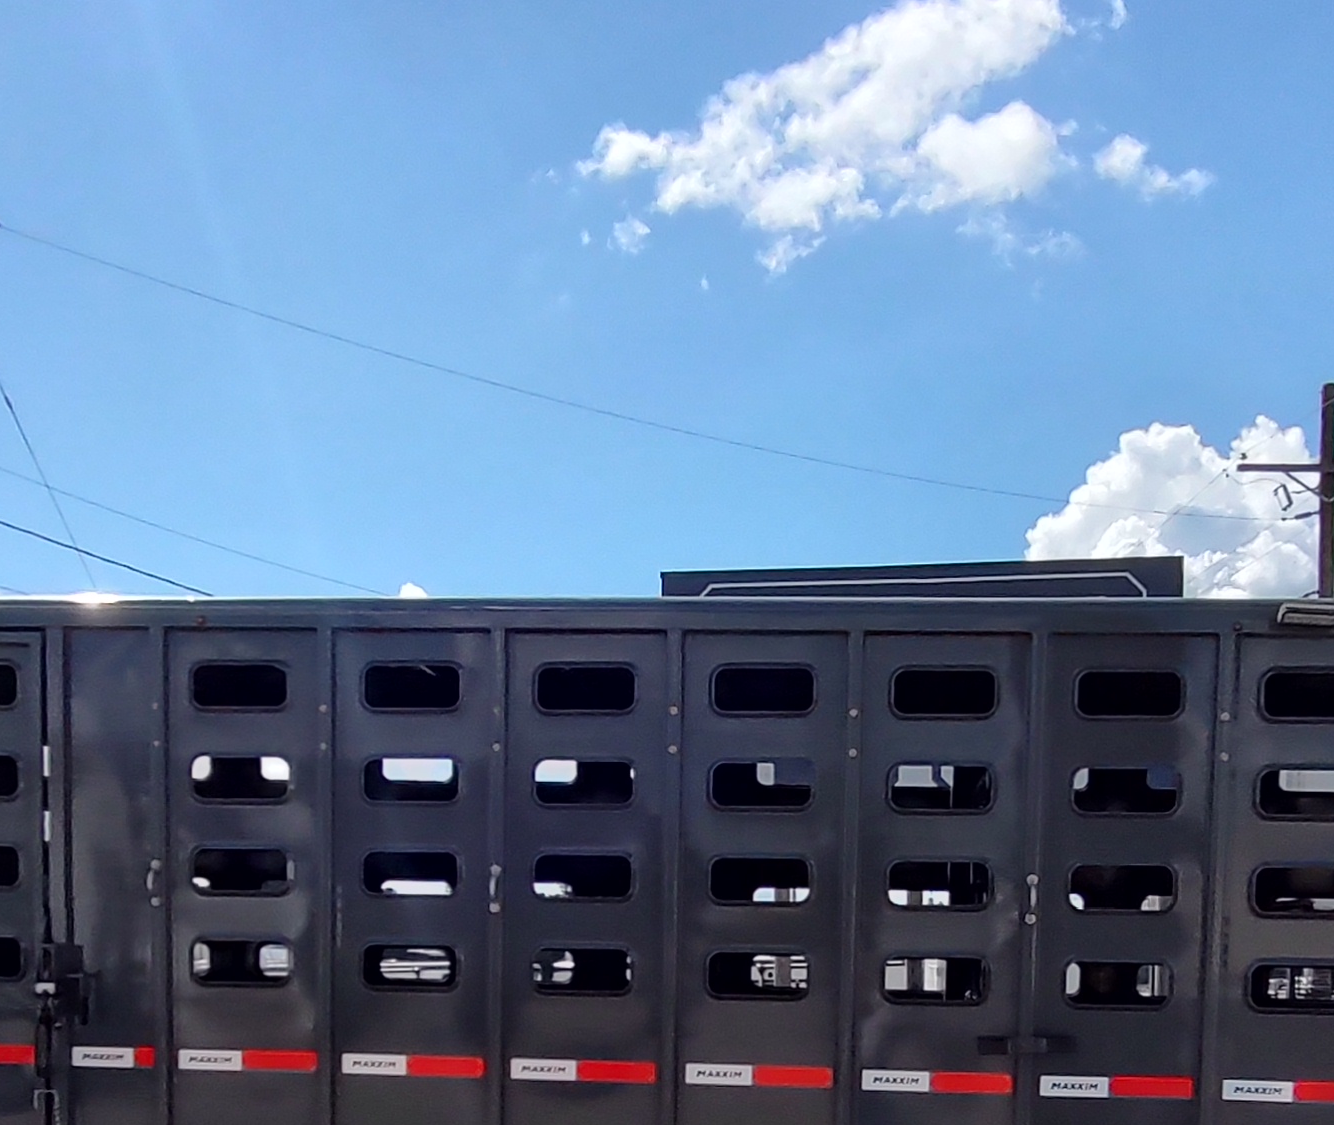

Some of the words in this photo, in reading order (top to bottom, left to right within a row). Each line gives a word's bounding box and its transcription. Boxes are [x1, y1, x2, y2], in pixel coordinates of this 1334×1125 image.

[695, 1070, 743, 1078] MAXXIM
[872, 1076, 920, 1085] MAXXIM
[1050, 1082, 1099, 1091] MAXXIM
[1232, 1086, 1283, 1095] MAXXIM
